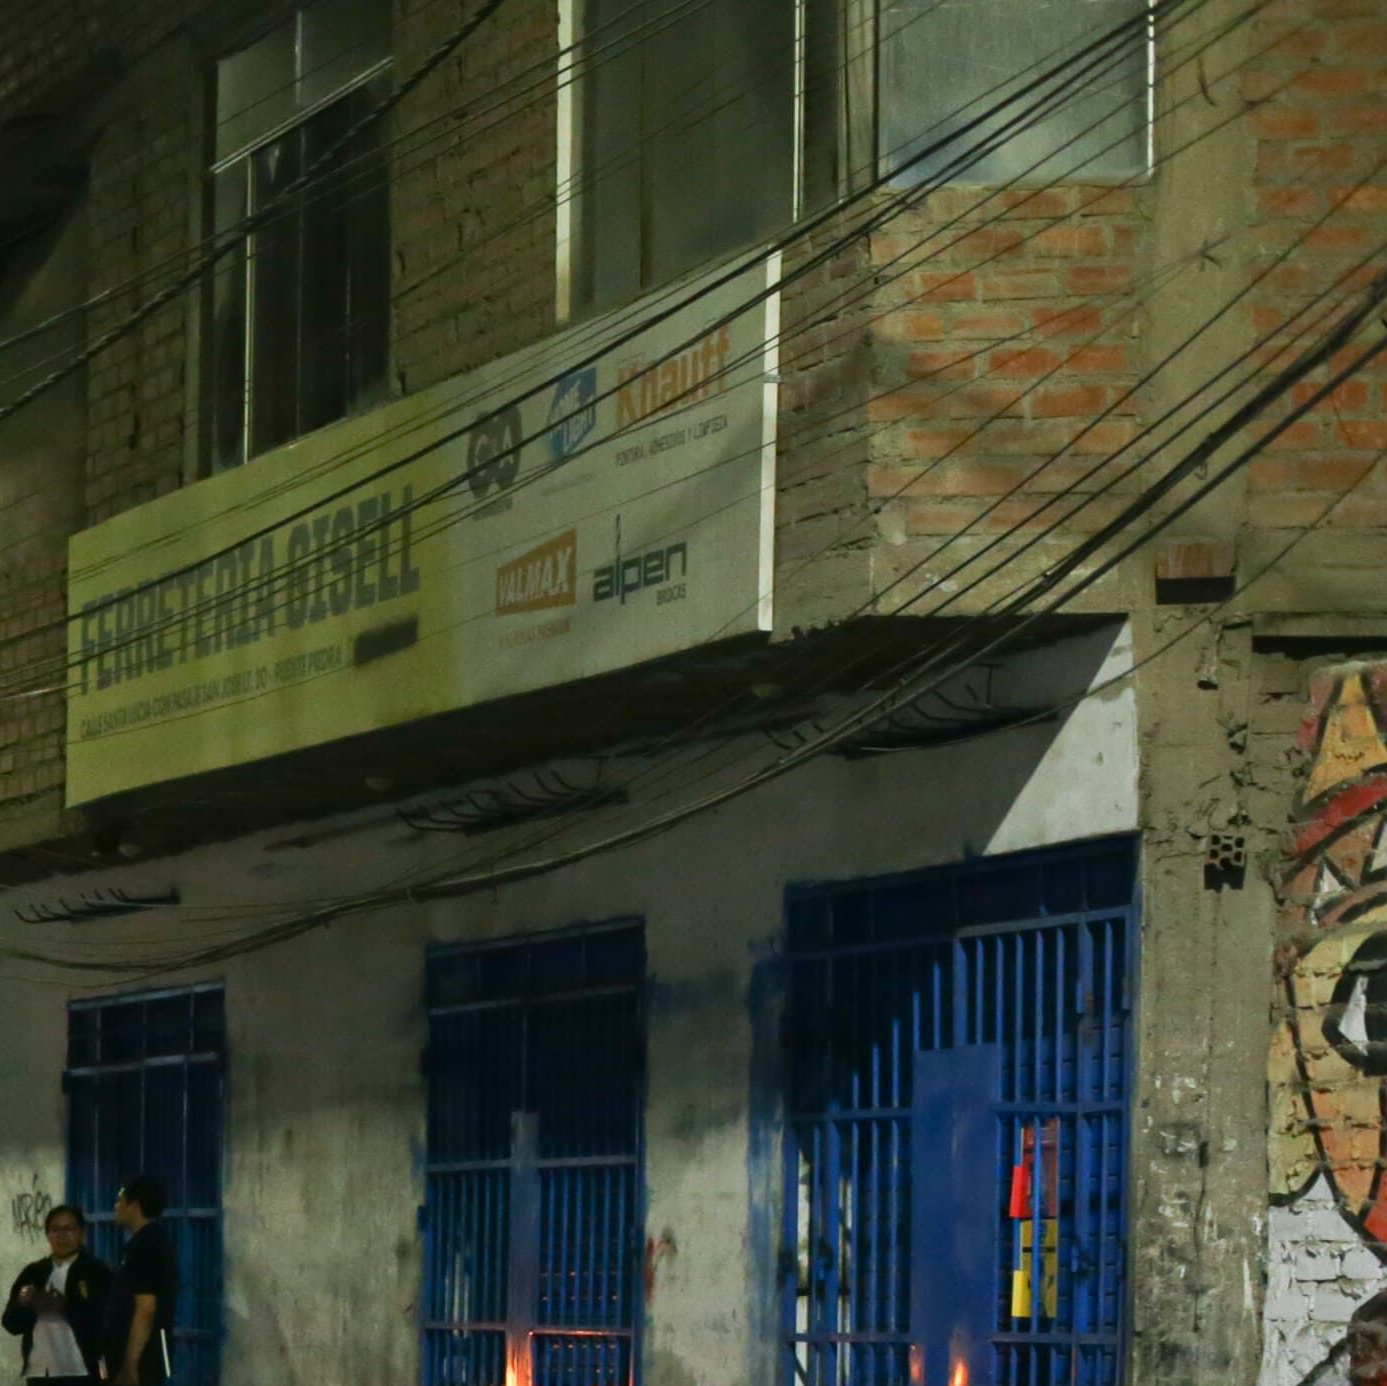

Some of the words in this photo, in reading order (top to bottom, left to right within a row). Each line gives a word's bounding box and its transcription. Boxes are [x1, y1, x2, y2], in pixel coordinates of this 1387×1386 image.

[80, 534, 275, 695] FERRETERIA
[287, 484, 420, 630] GISELL
[498, 546, 574, 608] VALMAX
[593, 514, 687, 605] alpen
